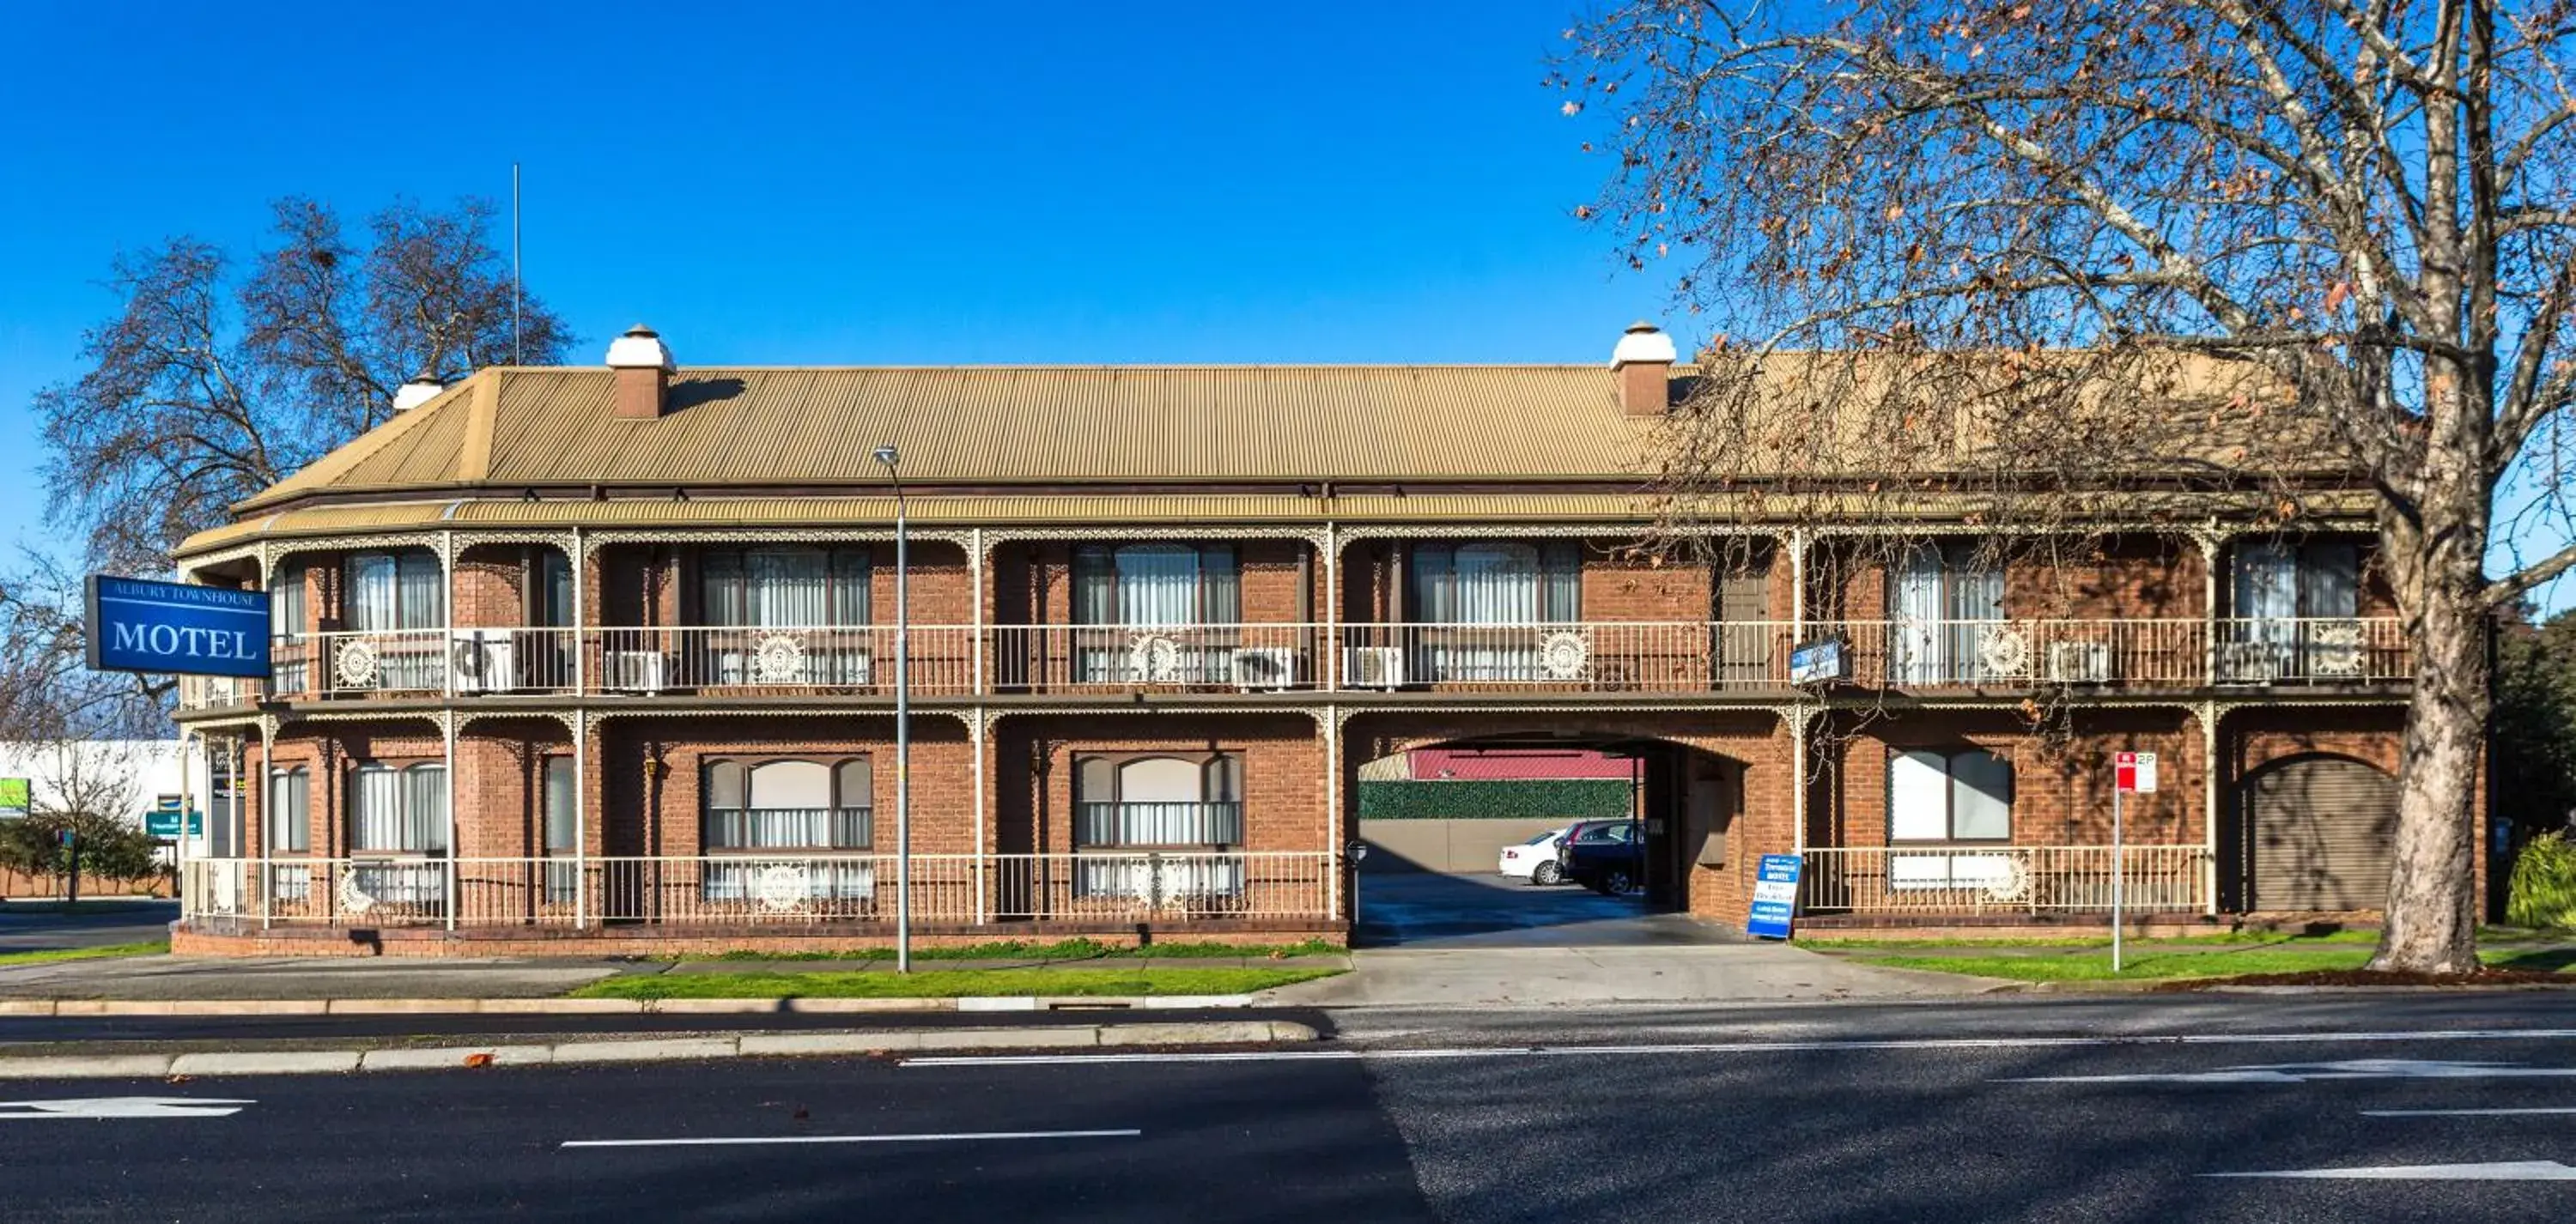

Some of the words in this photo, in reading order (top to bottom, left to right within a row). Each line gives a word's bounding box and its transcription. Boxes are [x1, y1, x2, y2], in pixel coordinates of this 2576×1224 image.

[114, 582, 167, 598] ALBURY
[172, 587, 255, 606] TOWNHOUSE
[112, 621, 257, 659] MOTEL
[2138, 755, 2154, 764] 2P
